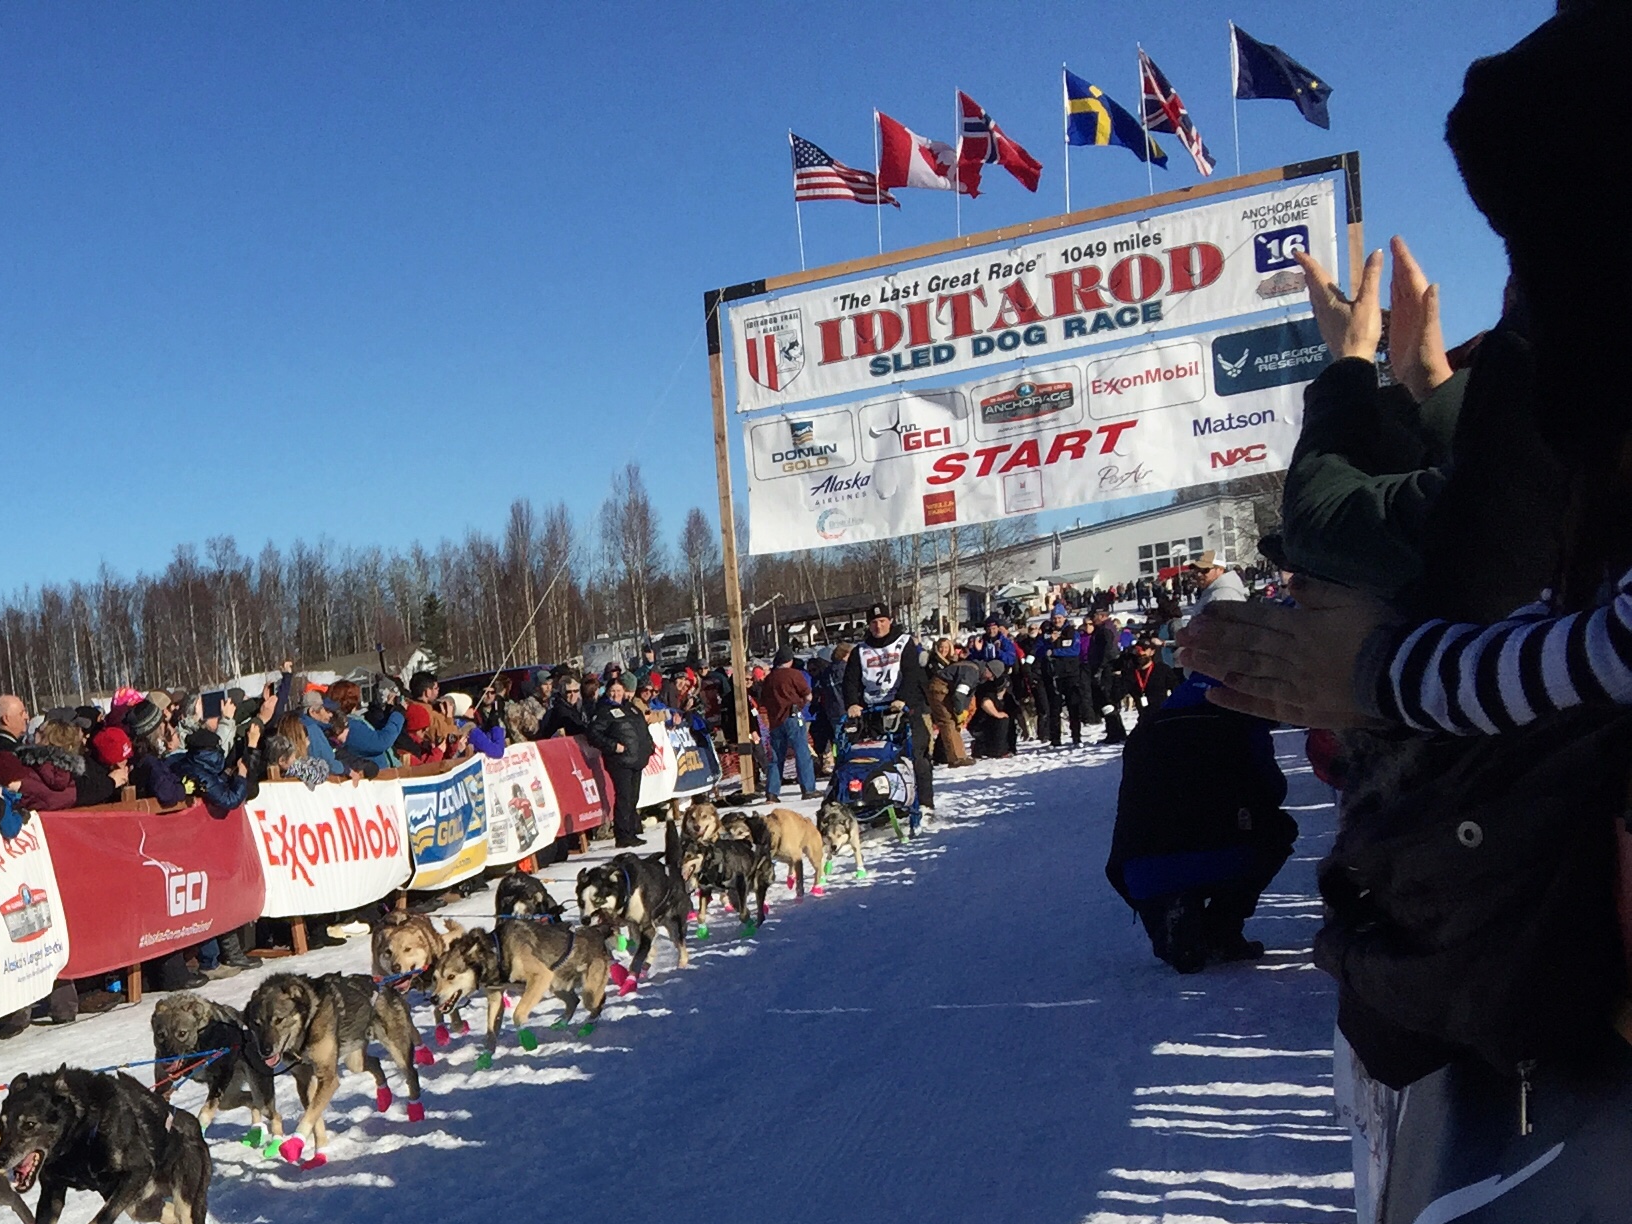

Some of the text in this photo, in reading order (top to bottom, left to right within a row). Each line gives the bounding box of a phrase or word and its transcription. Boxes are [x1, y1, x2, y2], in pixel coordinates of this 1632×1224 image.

[1241, 195, 1318, 221] ANCHORAGE
[1251, 209, 1310, 230] TO NOME
[879, 282, 920, 303] Last
[927, 268, 981, 293] Great
[1060, 240, 1108, 264] 1049
[1113, 231, 1163, 254] miles
[814, 241, 1225, 367] IDITAROD
[869, 299, 1164, 378] SLED DOG RACE
[1254, 342, 1328, 366] AIR FORCE
[1257, 352, 1324, 373] RESERVE
[1090, 360, 1200, 396] ExxonMobil
[985, 390, 1071, 415] ANCHORAGE
[1192, 408, 1276, 437] Matson
[902, 426, 953, 452] GCI
[925, 418, 1139, 486] START
[772, 443, 838, 464] DONLIN
[782, 456, 830, 473] GOLD
[1210, 443, 1267, 469] NAC
[810, 471, 871, 496] Alaska
[814, 490, 868, 506] AIRLINES
[875, 669, 892, 687] 24
[169, 870, 209, 917] GCI
